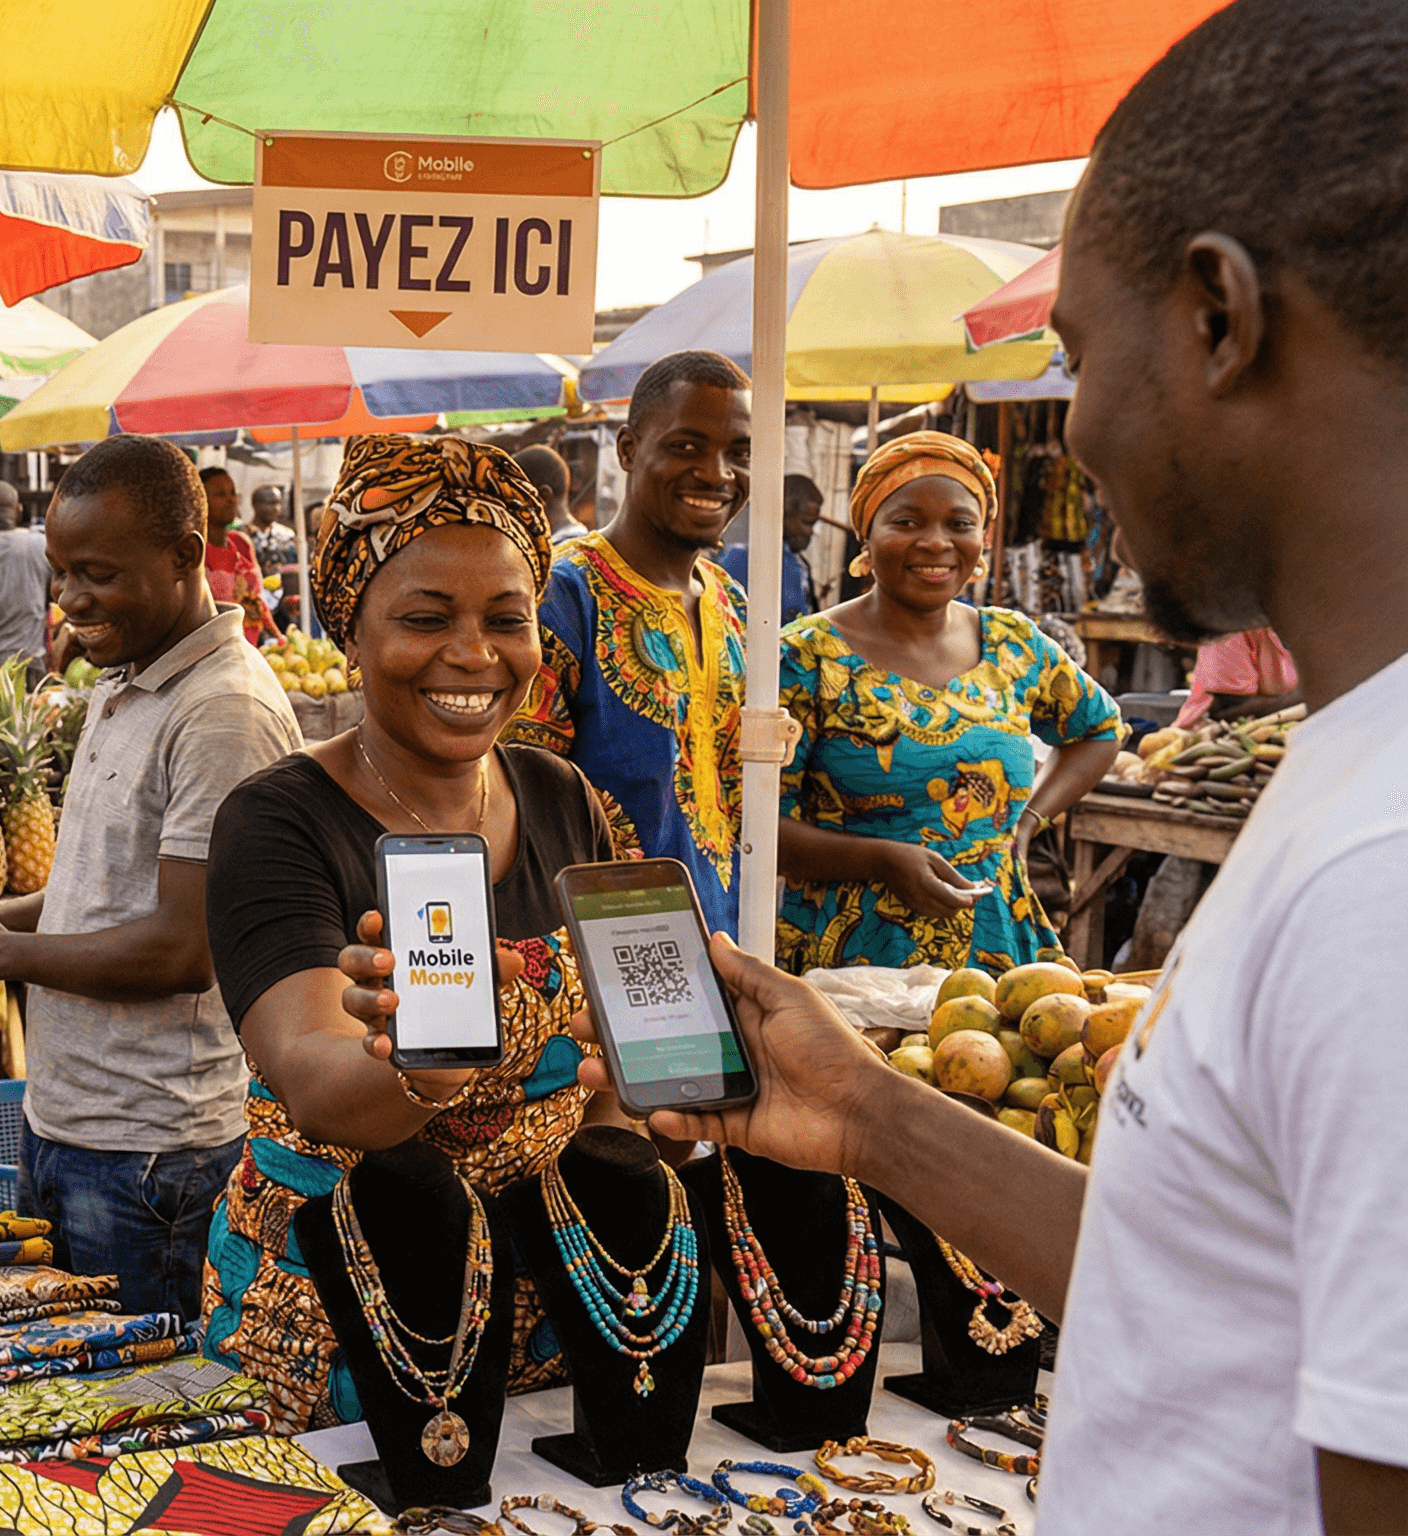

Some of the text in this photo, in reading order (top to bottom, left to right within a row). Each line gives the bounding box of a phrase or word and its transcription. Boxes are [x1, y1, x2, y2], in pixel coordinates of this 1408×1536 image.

[276, 209, 572, 296] PAYEZ ICI
[408, 948, 474, 967] Mobile
[409, 968, 475, 989] Money
